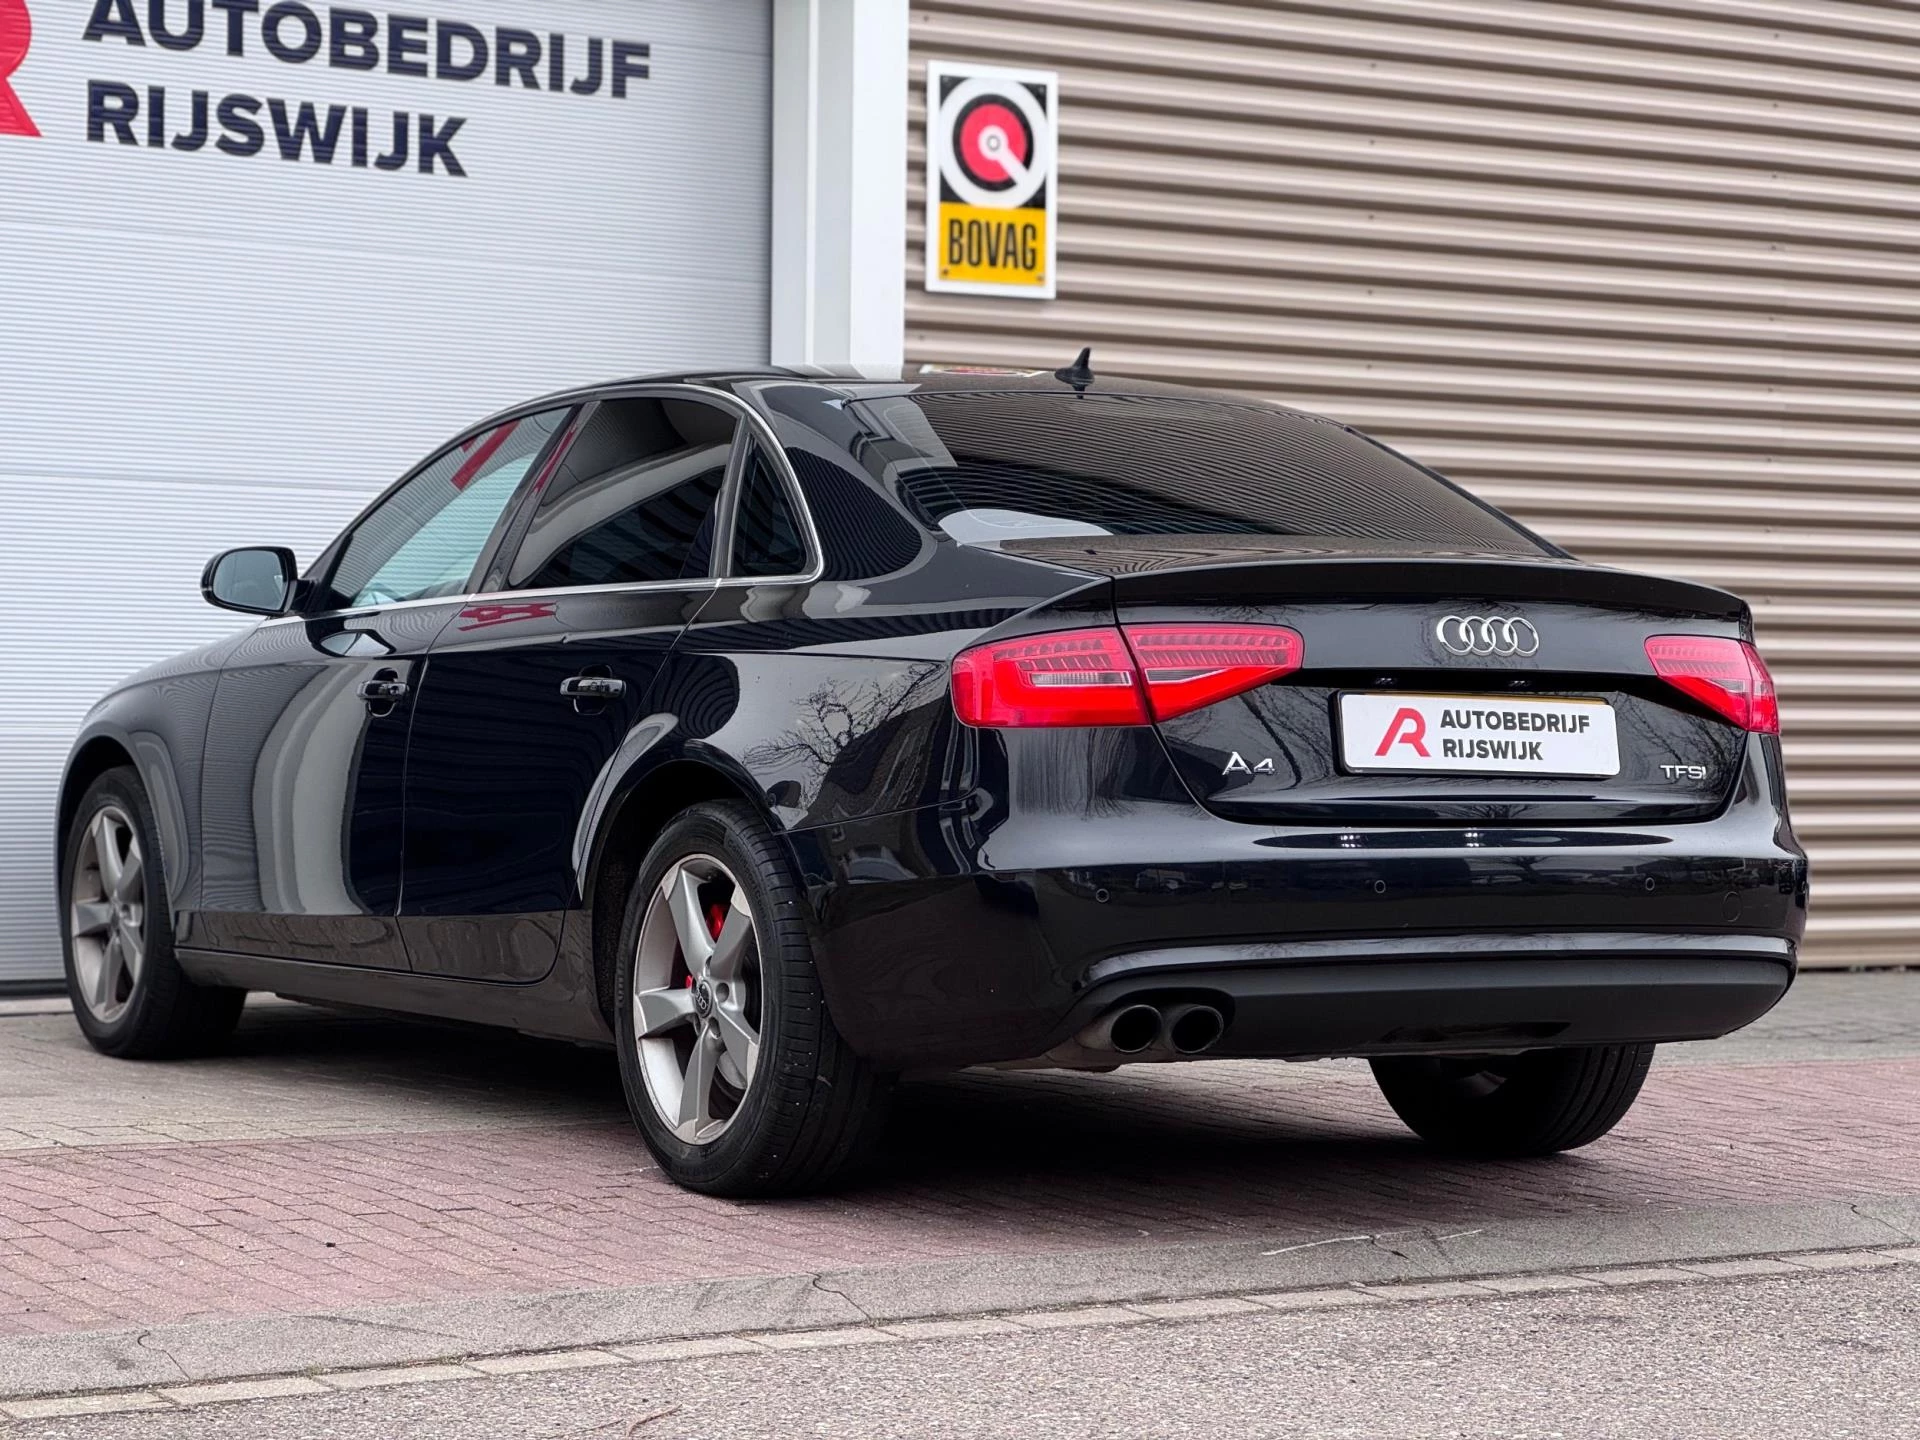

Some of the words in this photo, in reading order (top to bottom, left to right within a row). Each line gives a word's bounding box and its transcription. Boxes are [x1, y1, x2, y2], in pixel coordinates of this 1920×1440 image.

[82, 0, 650, 99] AUTOBEDRIJF
[86, 79, 468, 178] RIJSWIJK
[948, 218, 1037, 271] BOVAG
[1440, 709, 1590, 733] AUTOBEDRIJF
[1442, 738, 1544, 761] RIJSWIJK
[1222, 751, 1275, 775] A4
[1660, 764, 1706, 780] TFSI
